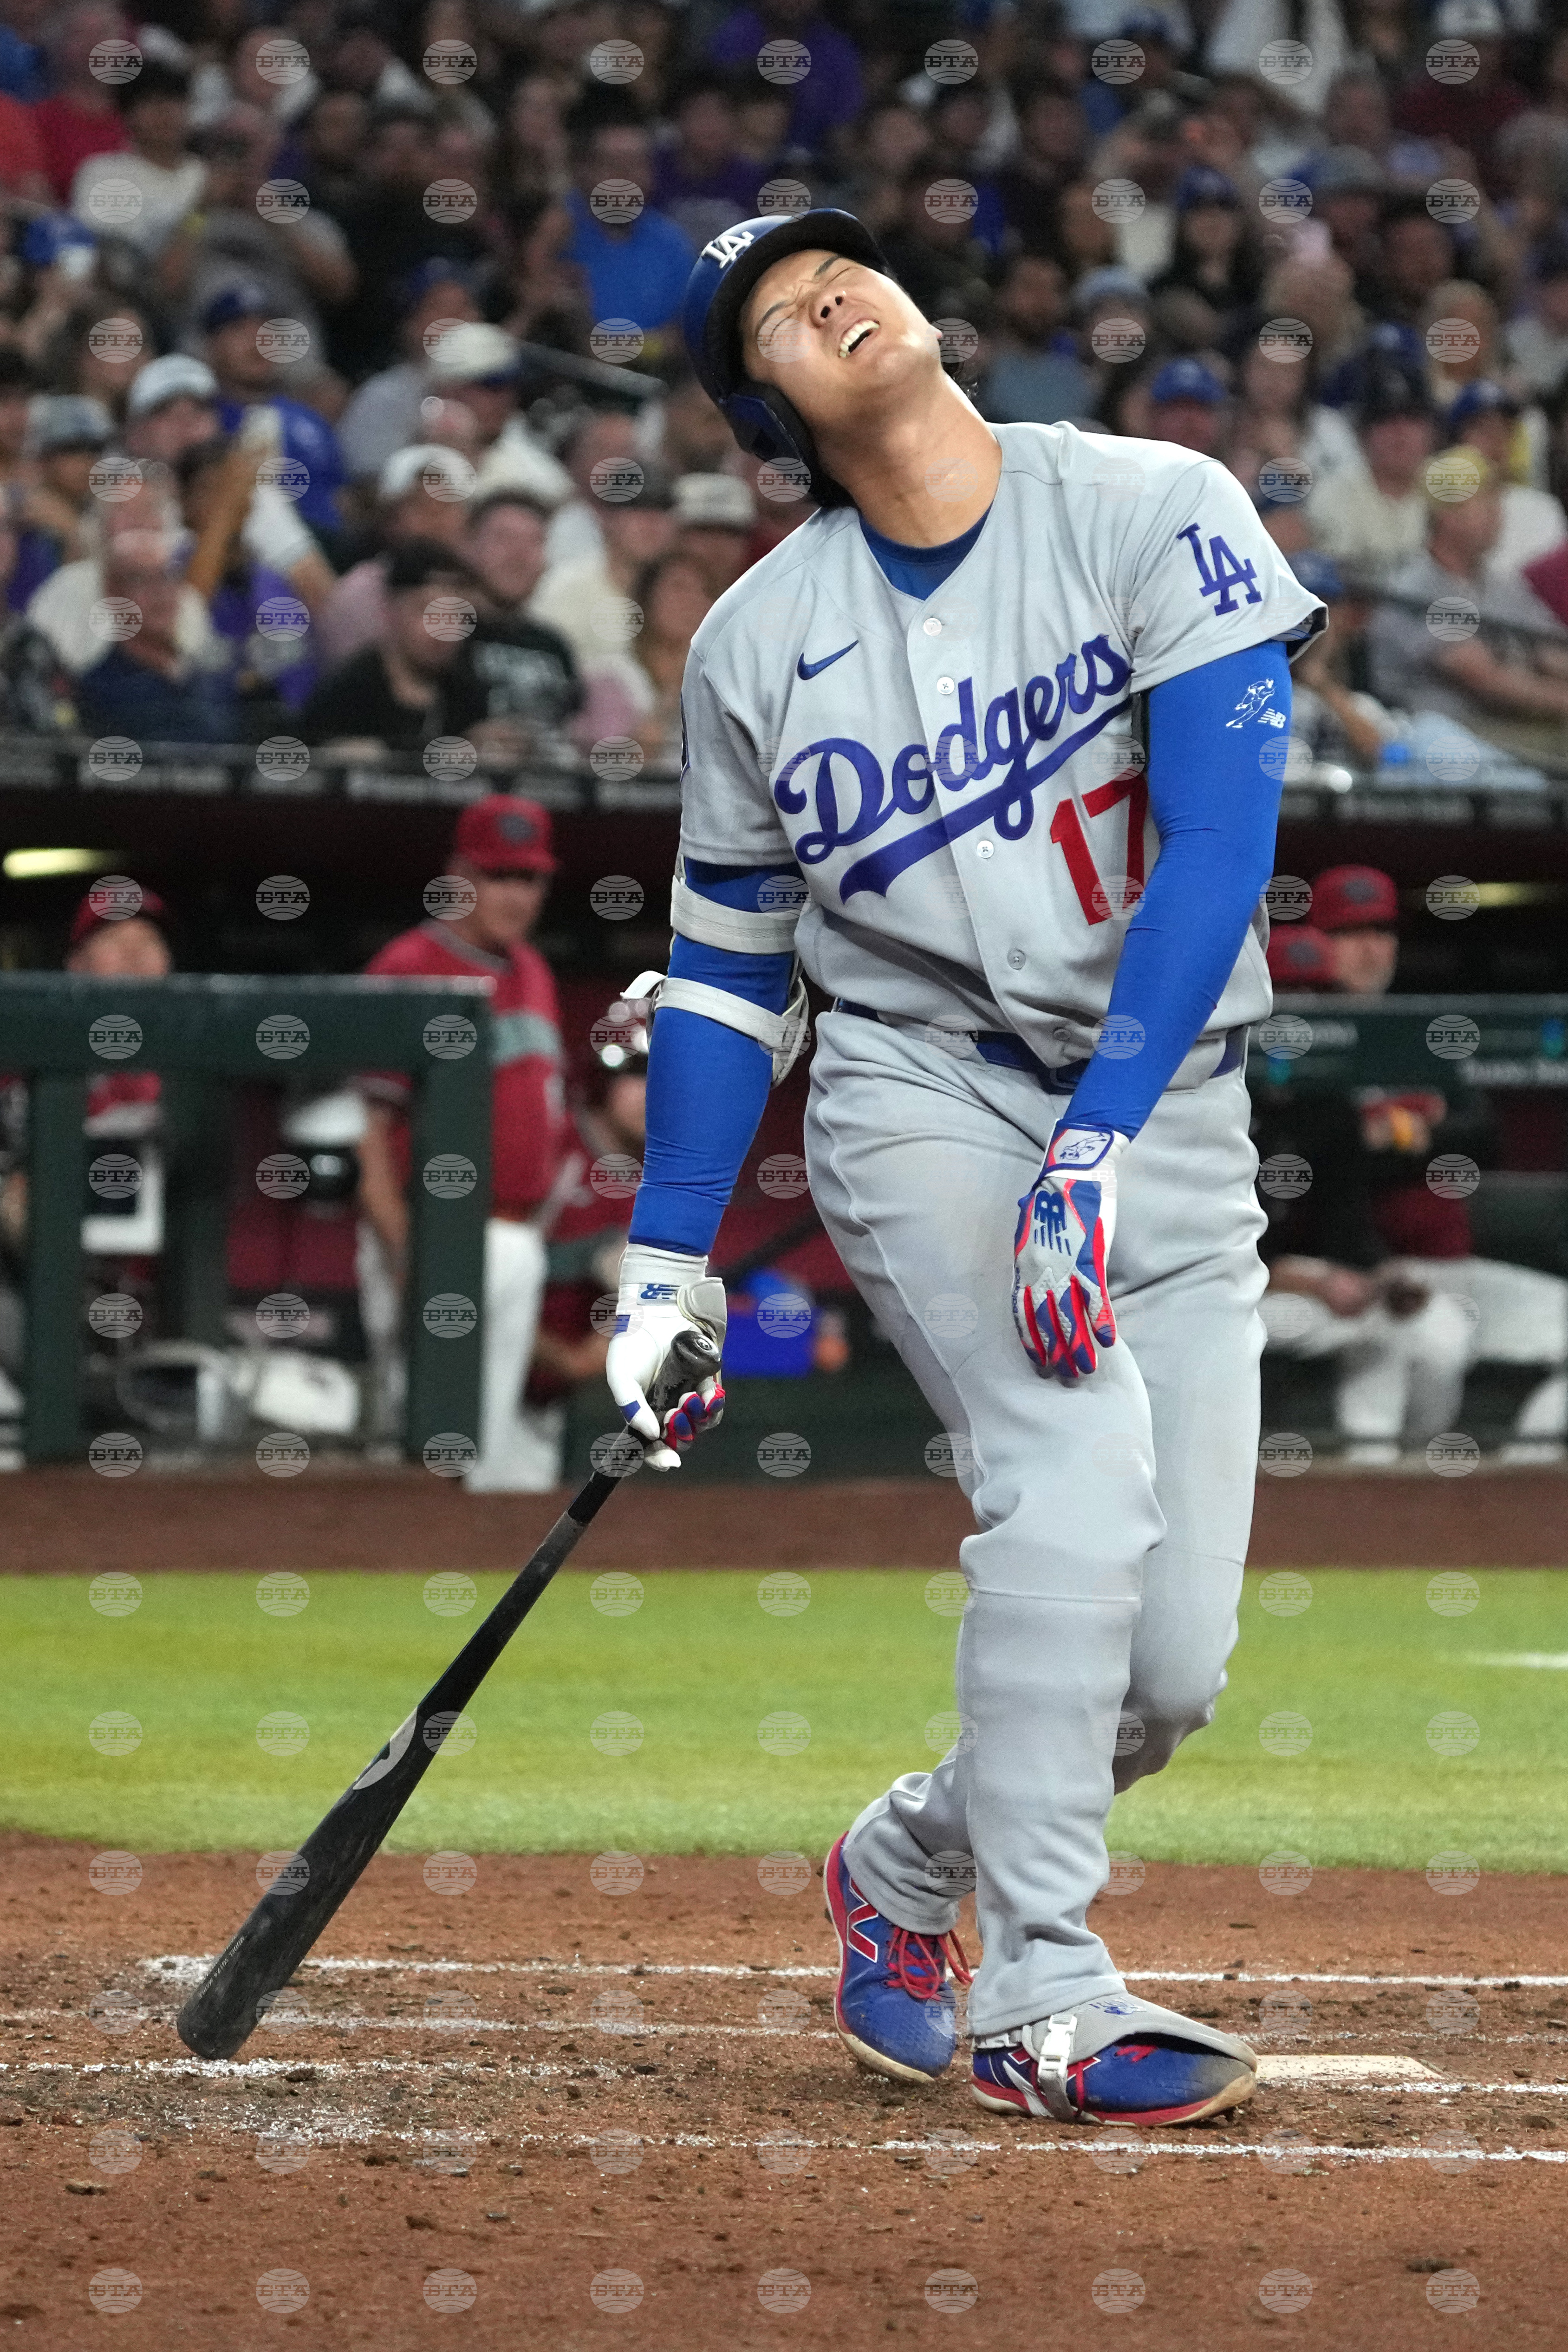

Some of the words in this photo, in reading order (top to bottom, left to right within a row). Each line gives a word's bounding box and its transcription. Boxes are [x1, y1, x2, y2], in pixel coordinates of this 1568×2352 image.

[701, 231, 755, 269] LA
[1176, 522, 1262, 616] LA
[774, 633, 1134, 865] Dodgers
[1050, 772, 1149, 925] 17
